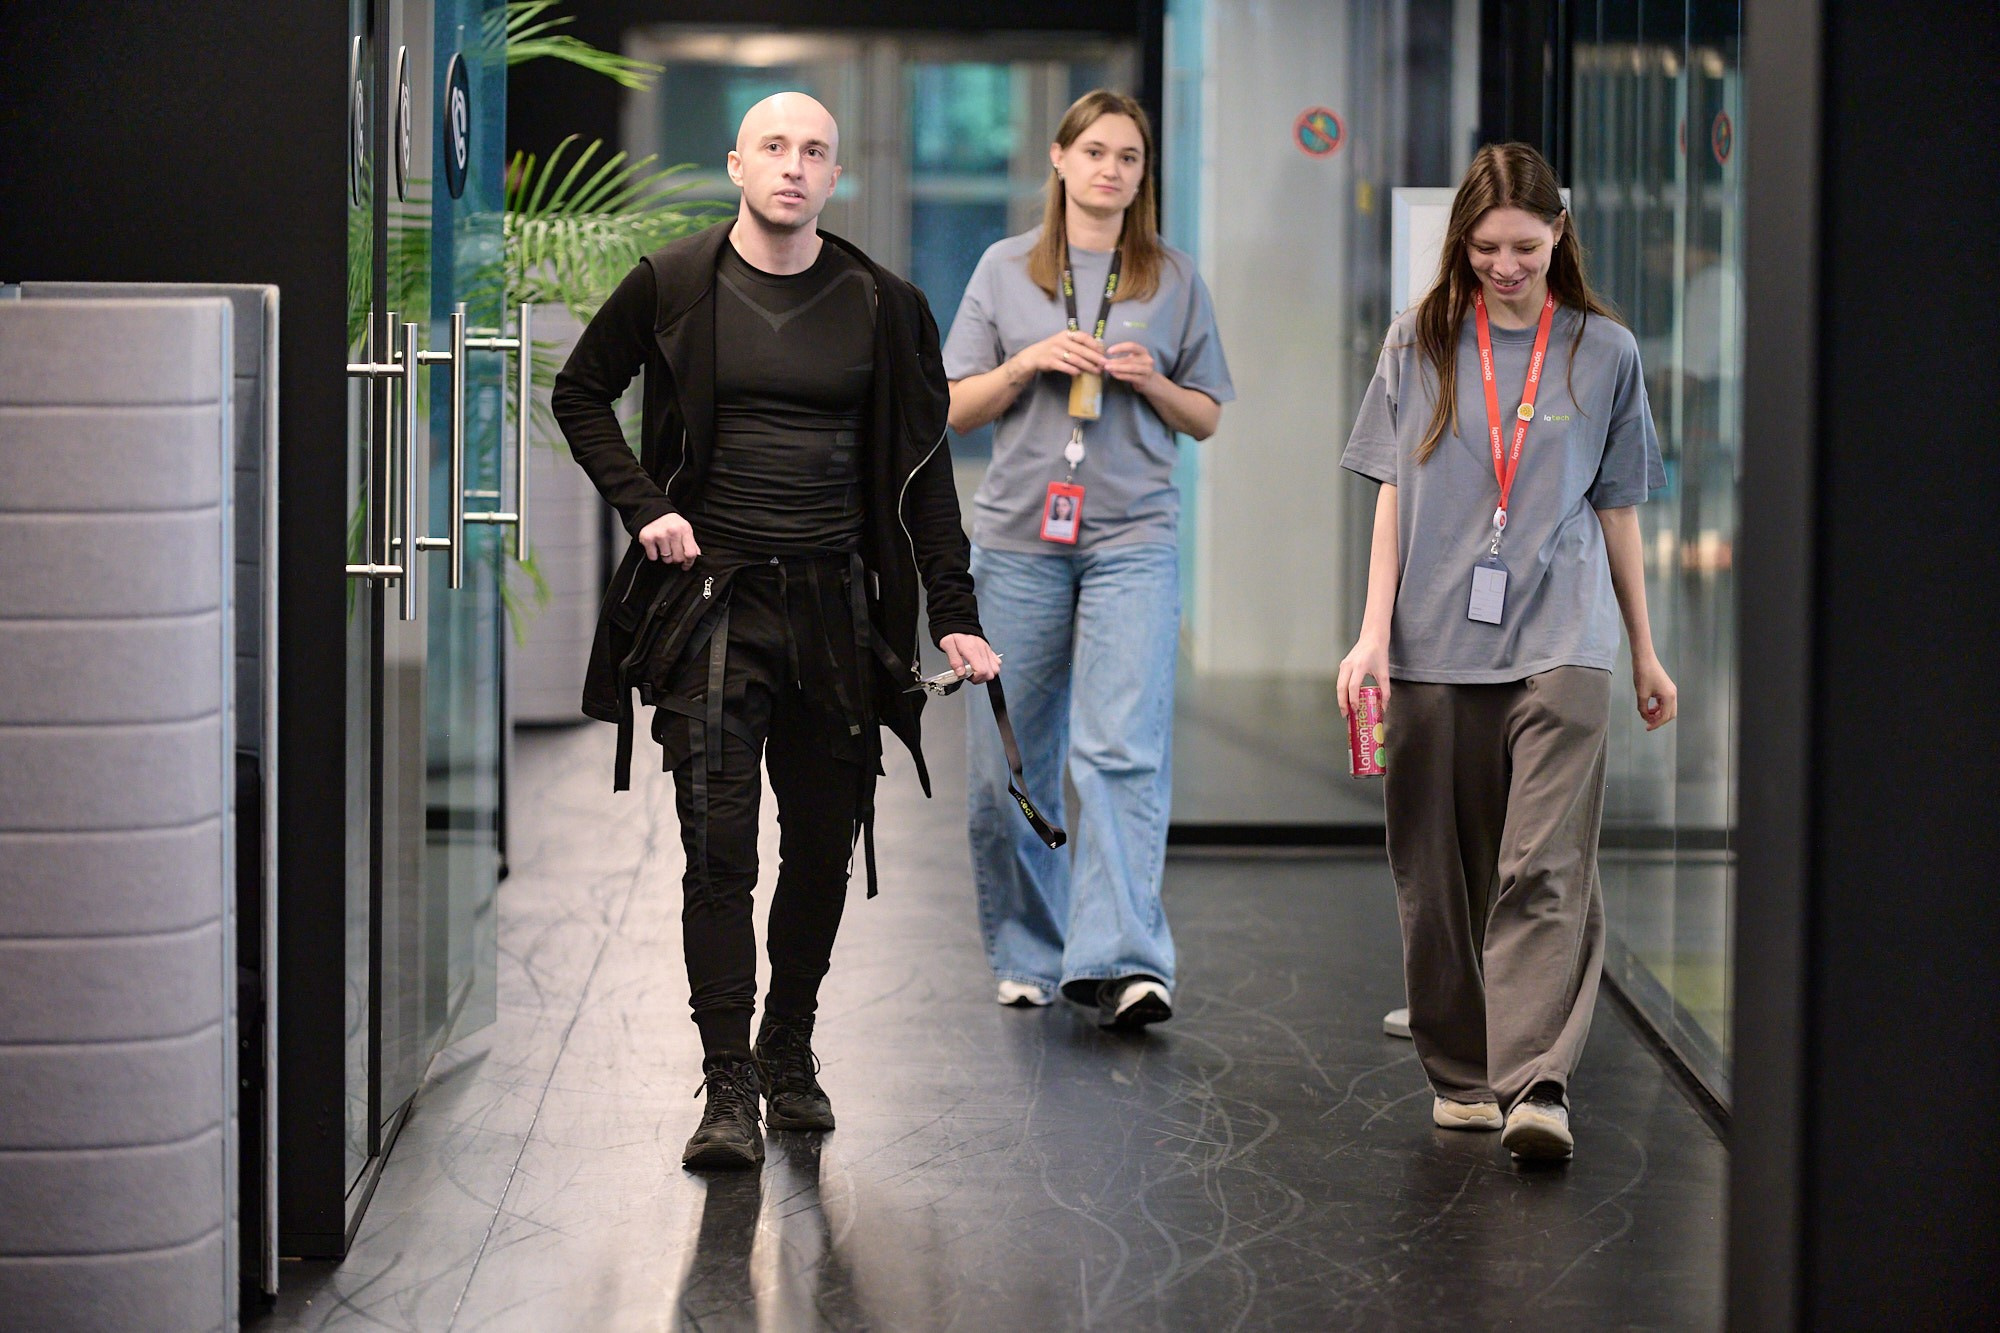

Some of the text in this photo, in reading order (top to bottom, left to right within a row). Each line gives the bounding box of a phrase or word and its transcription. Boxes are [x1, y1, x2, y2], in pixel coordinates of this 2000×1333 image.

[1482, 349, 1493, 382] lamoda
[1528, 352, 1543, 384] lamoda
[1543, 414, 1570, 422] latech
[1491, 426, 1502, 460] lamoda
[1511, 427, 1525, 460] lamoda
